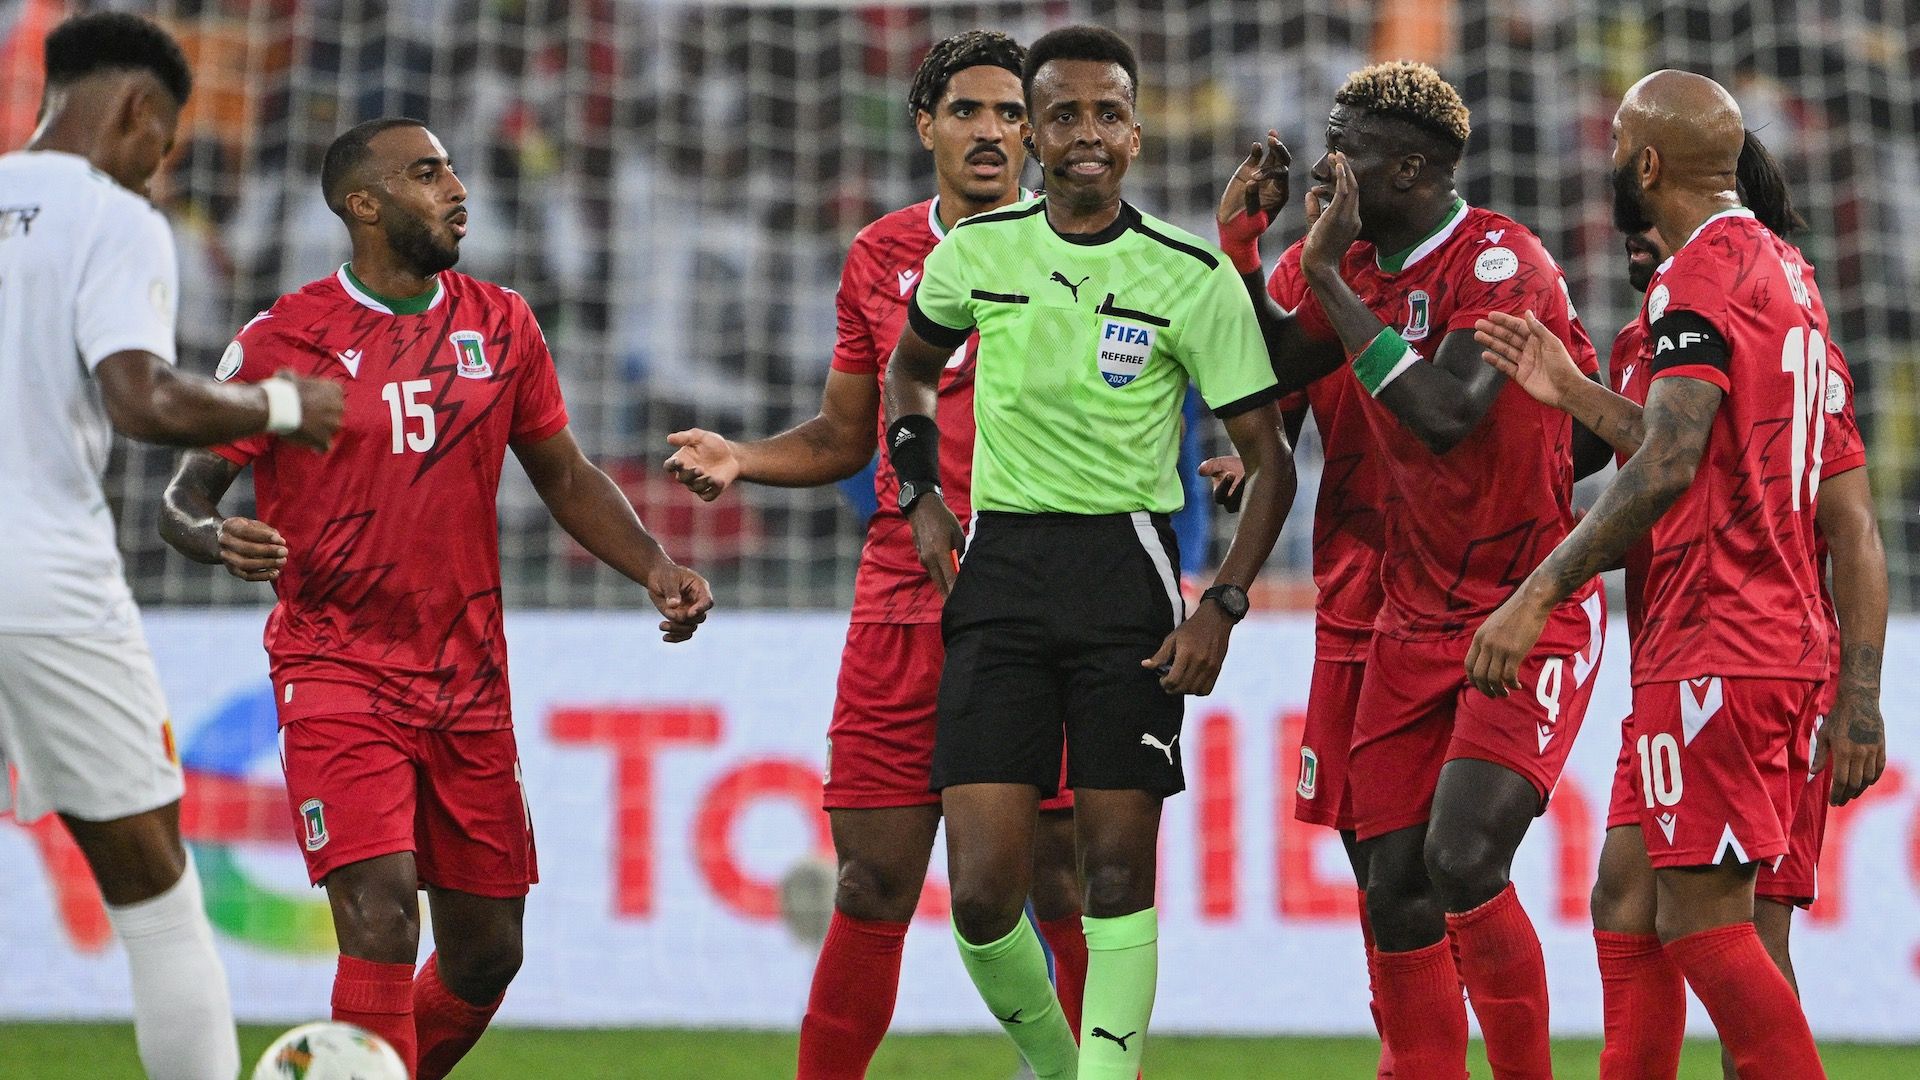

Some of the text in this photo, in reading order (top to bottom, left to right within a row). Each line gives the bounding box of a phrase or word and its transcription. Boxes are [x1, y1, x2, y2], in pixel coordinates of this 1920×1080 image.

[1101, 350, 1145, 365] REFEREE
[1105, 323, 1149, 347] FIFA
[1652, 331, 1702, 359] AF
[1108, 374, 1129, 384] 2024
[381, 379, 437, 455] 15
[1781, 326, 1827, 512] 10
[1536, 656, 1564, 723] 4
[1636, 732, 1684, 809] 10
